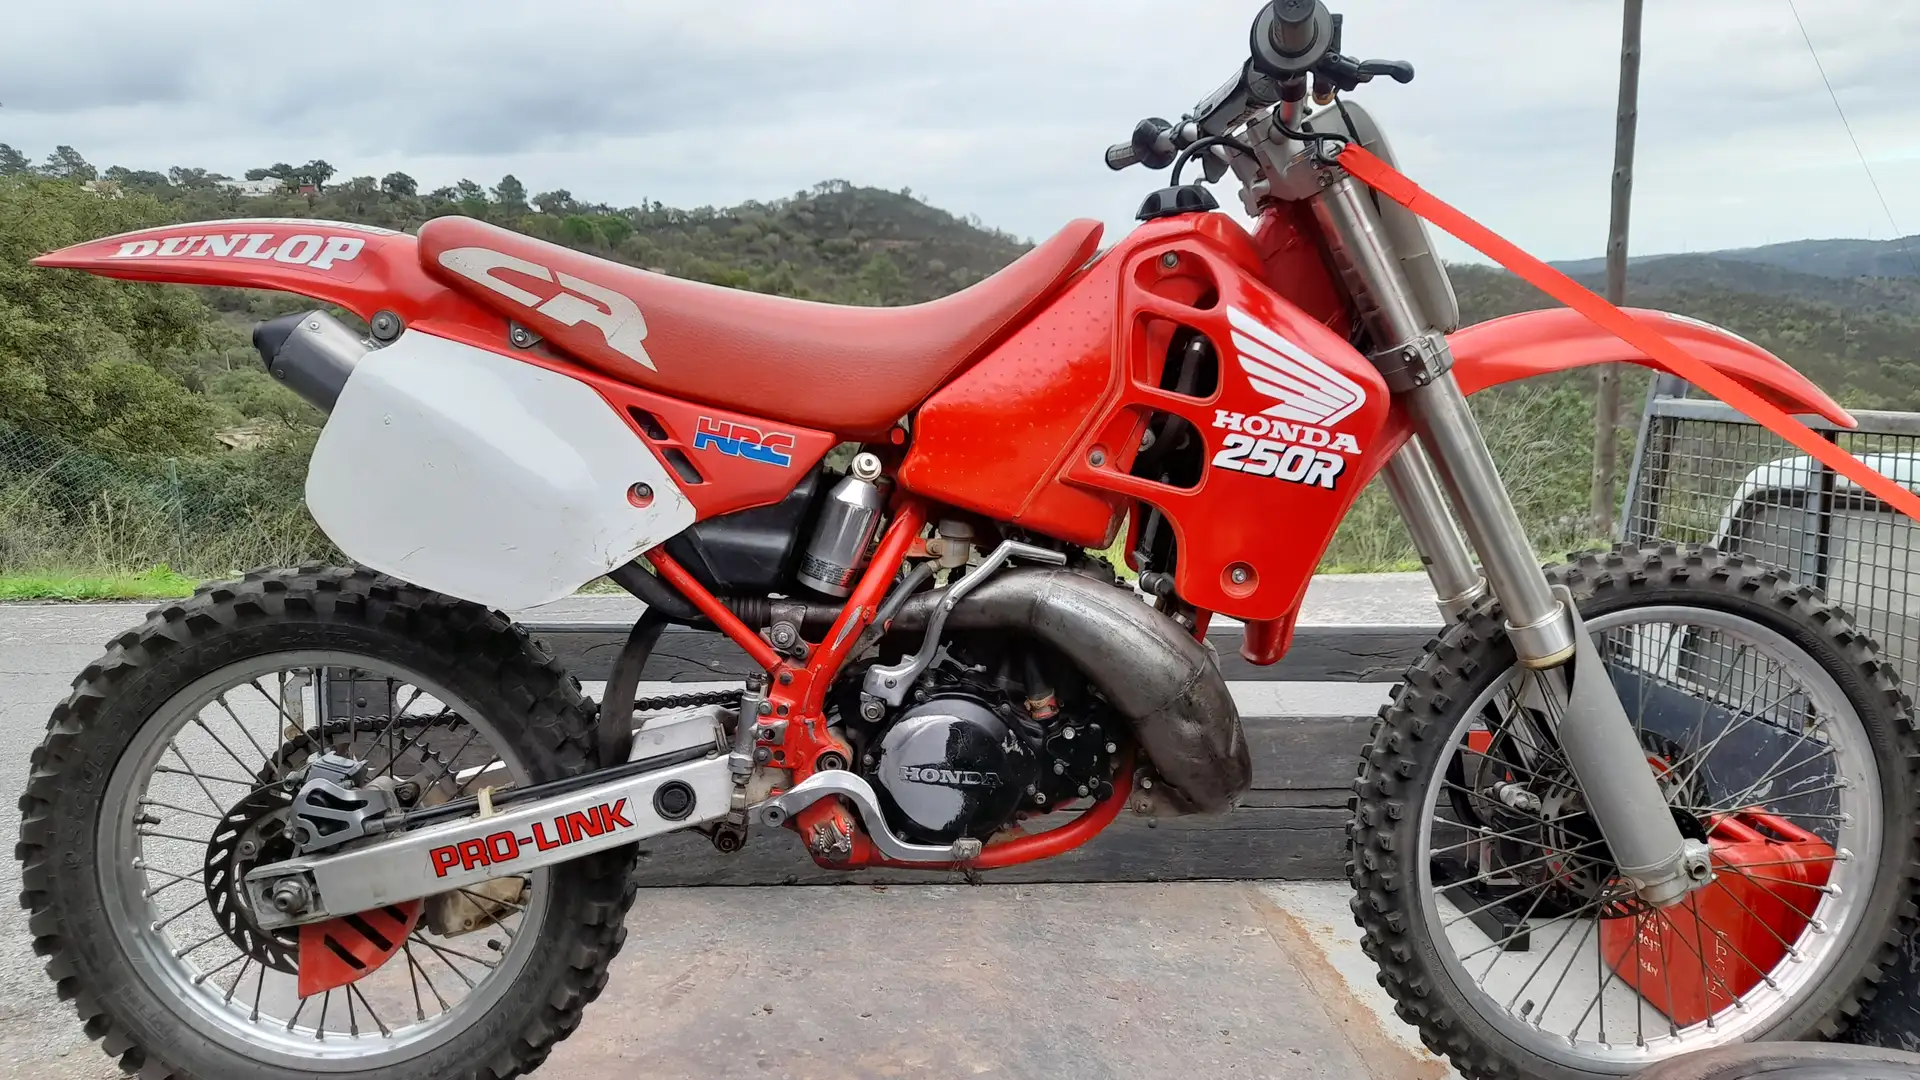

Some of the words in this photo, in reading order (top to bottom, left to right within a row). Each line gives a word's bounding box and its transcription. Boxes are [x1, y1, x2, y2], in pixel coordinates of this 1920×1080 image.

[108, 233, 366, 270] DUNLOP
[437, 246, 659, 373] CR
[692, 415, 796, 468] HRC
[1211, 409, 1363, 455] HONDA
[1211, 432, 1346, 490] 250R
[899, 766, 1004, 787] HONDA
[429, 797, 634, 878] PRO-LINK
